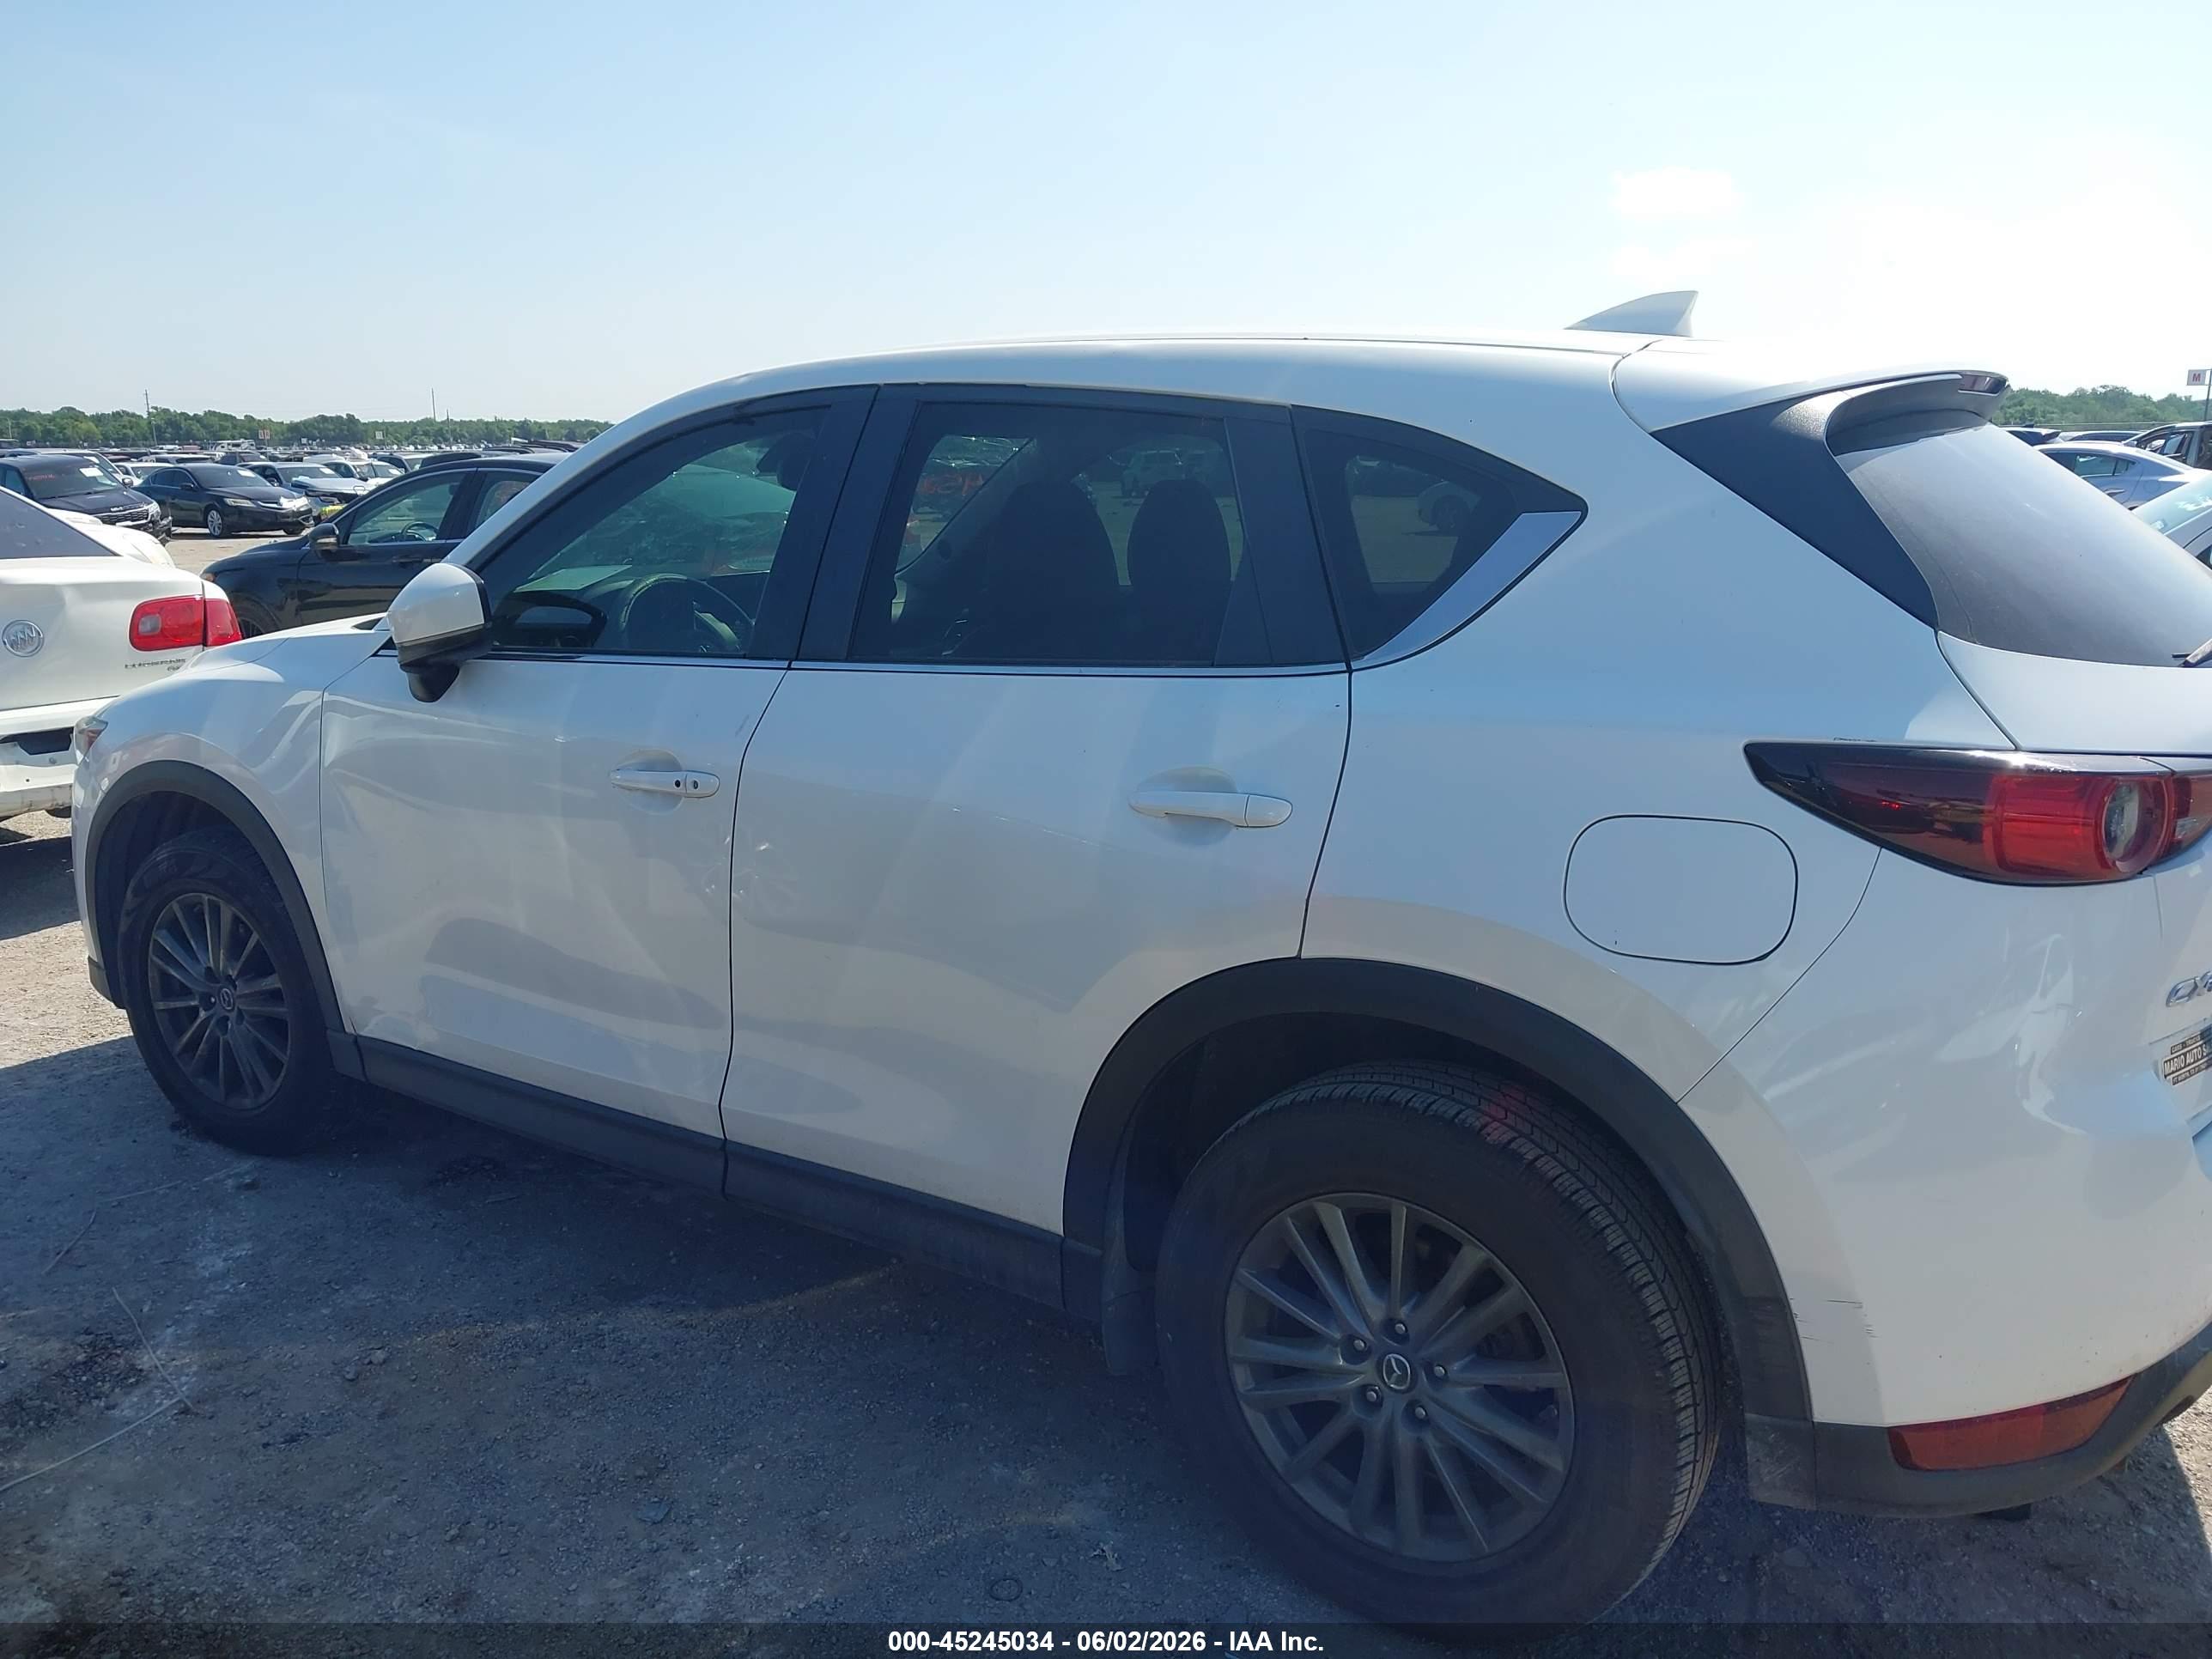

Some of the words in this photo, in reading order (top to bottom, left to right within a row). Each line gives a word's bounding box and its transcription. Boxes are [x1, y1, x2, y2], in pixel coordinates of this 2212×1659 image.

[2192, 373, 2201, 382] M
[2164, 1054, 2185, 1075] MARIO
[2186, 1047, 2203, 1066] AUTO
